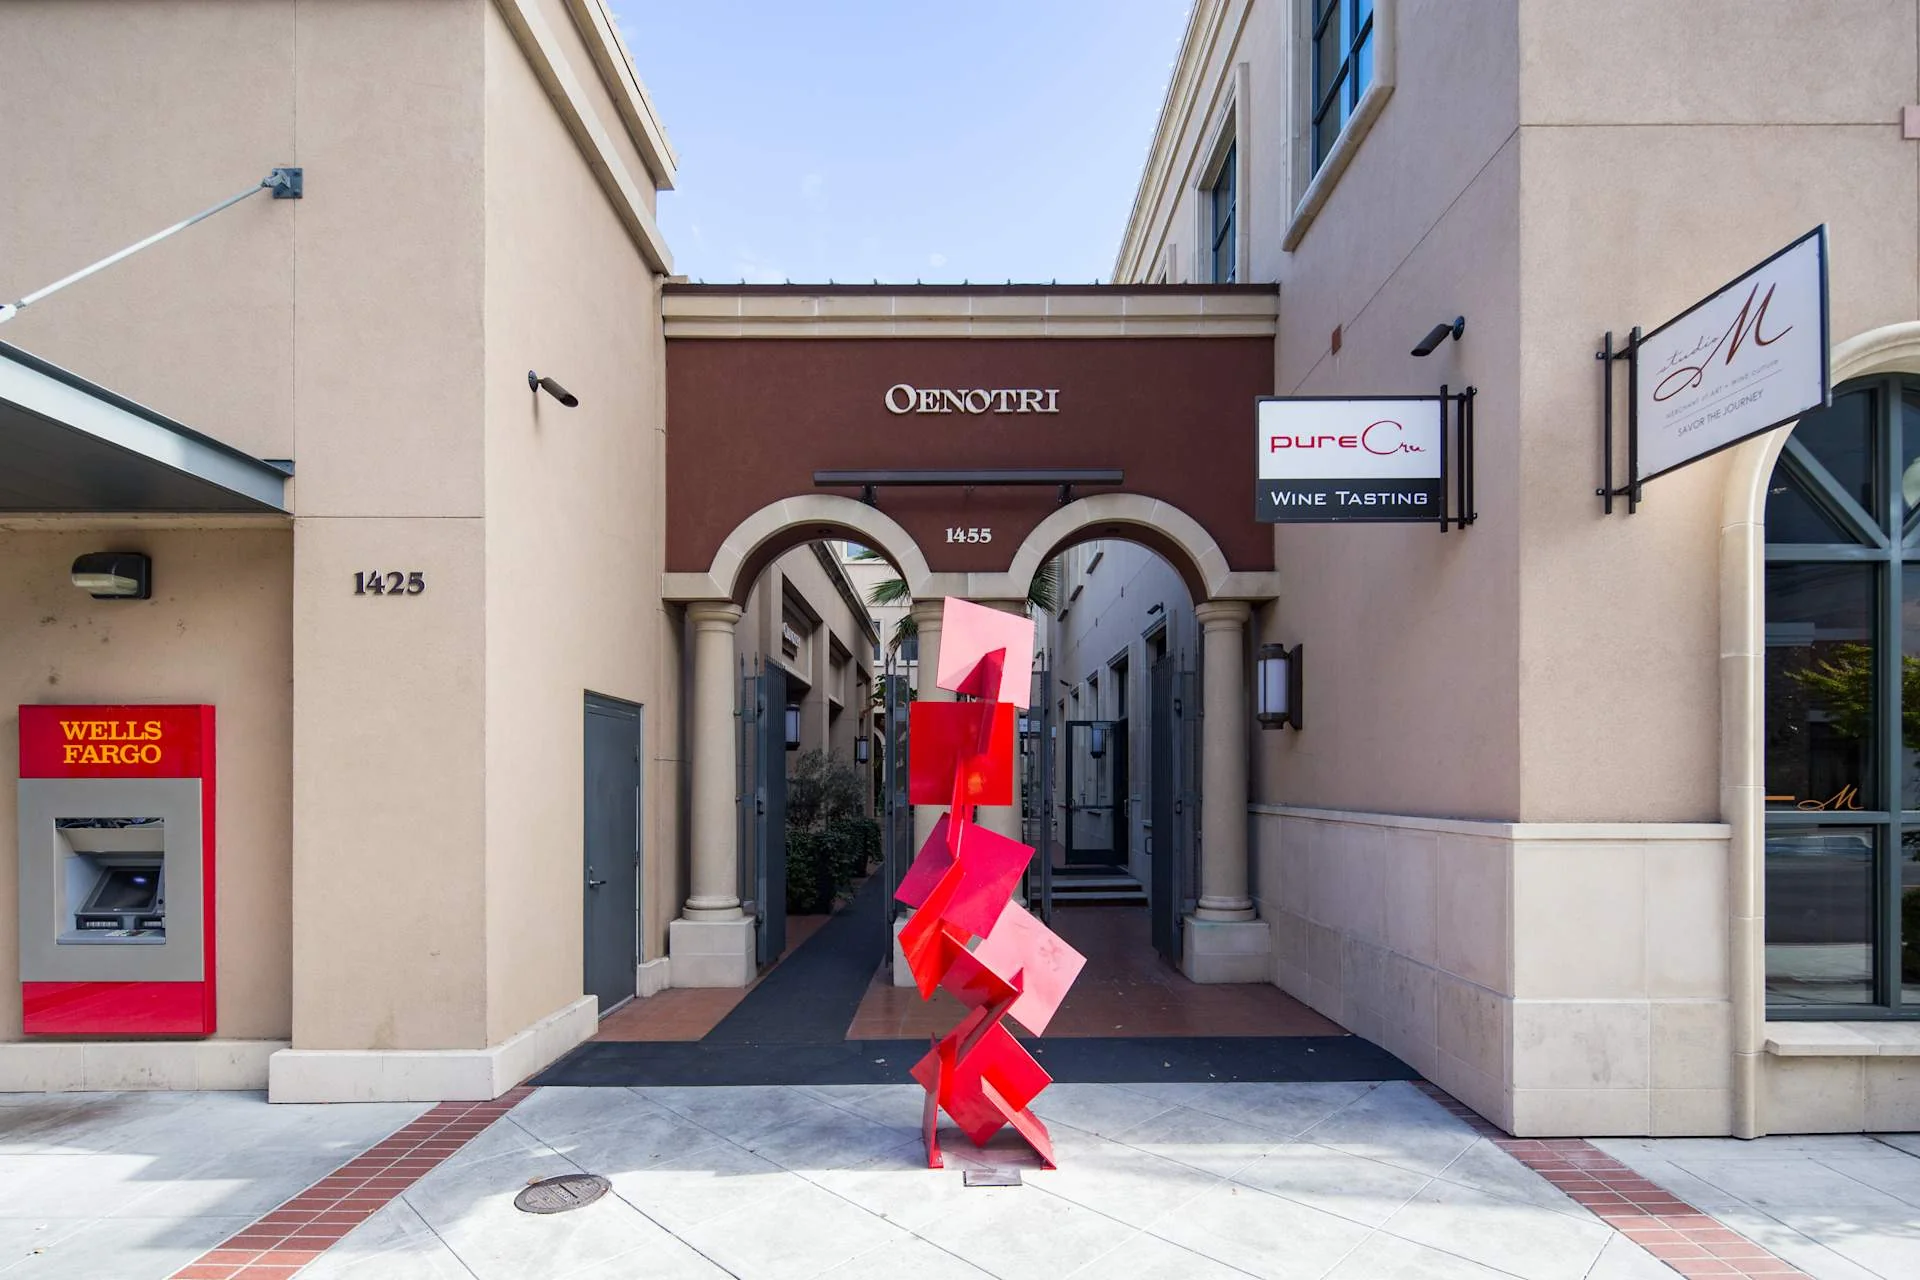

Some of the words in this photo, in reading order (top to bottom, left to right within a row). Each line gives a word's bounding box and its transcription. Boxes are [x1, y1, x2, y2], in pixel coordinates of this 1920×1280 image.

[1653, 282, 1793, 402] M
[884, 383, 1060, 414] OENOTRI
[1678, 417, 1705, 437] SAVOR
[1707, 408, 1721, 424] THE
[1722, 387, 1764, 416] JOURNEY
[945, 527, 992, 544] 1455
[354, 570, 426, 595] 1425
[59, 720, 162, 741] WELLS
[63, 744, 162, 764] FARGO
